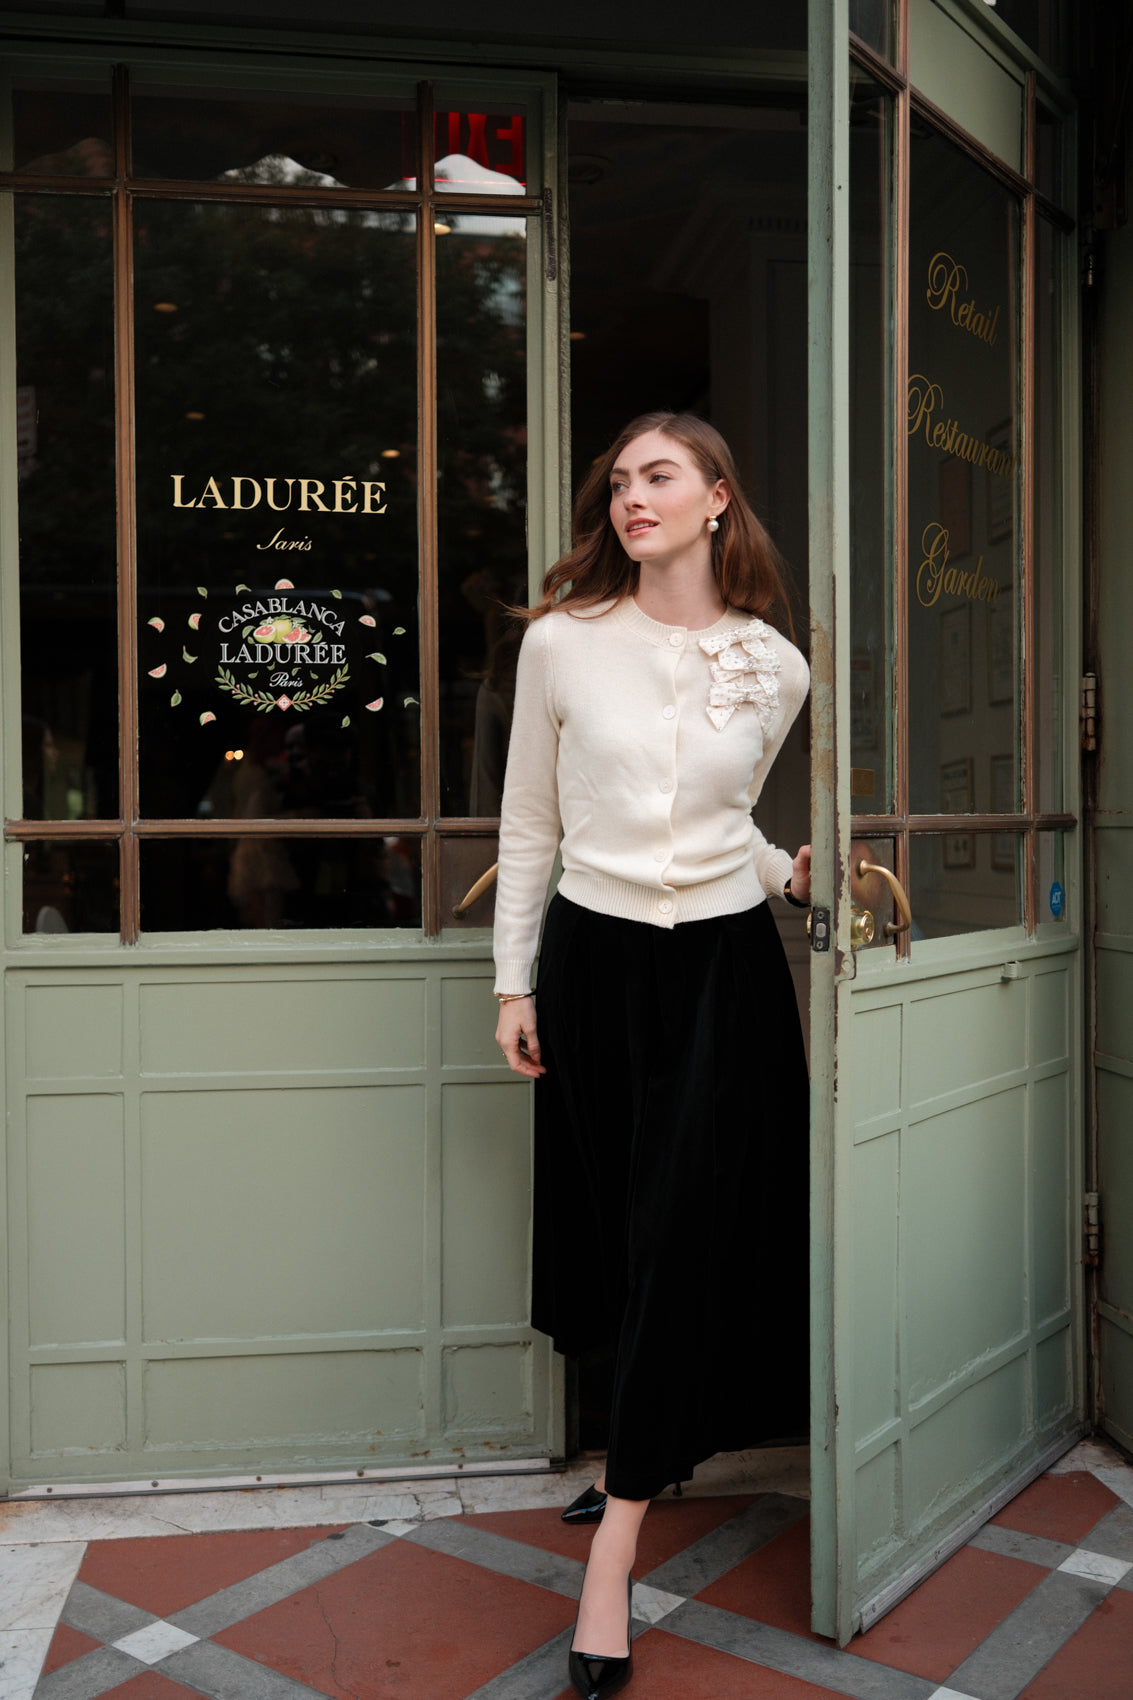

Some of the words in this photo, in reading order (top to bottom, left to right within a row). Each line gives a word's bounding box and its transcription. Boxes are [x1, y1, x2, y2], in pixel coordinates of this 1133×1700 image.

[926, 252, 1000, 346] Retail
[170, 474, 388, 514] LADURÉE
[916, 522, 1000, 607] Garden
[218, 597, 346, 637] CASABLANCA
[219, 642, 347, 664] LADURÉE
[268, 671, 304, 688] Paris
